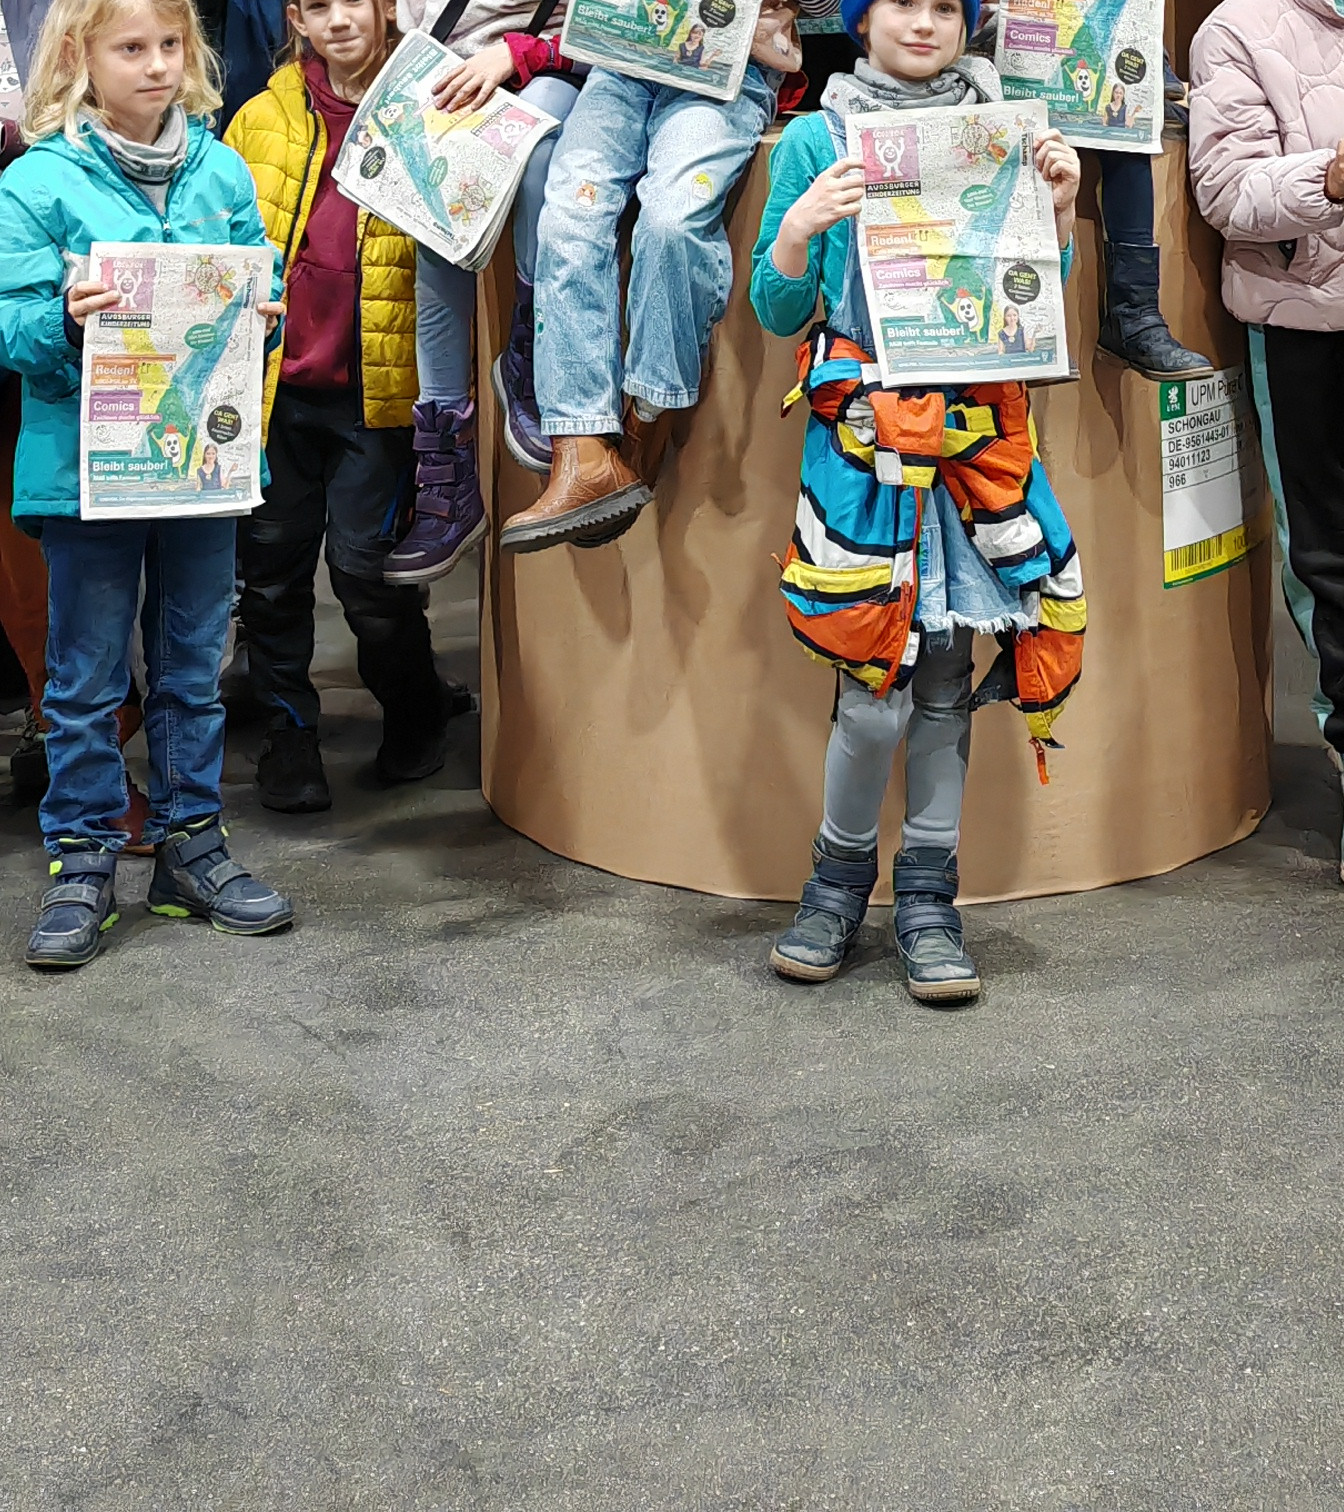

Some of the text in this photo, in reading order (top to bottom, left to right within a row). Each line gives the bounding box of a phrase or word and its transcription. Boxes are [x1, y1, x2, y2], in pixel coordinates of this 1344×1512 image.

[577, 4, 653, 35] Bleibt sauber!
[1010, 29, 1051, 44] Comics
[1003, 85, 1080, 103] Bleibt sauber!
[876, 268, 921, 279] Comics
[887, 325, 965, 338] Bleibt sauber!
[1191, 381, 1217, 407] UPM
[94, 401, 135, 412] Comics
[1168, 409, 1220, 434] SCHONGAU
[1168, 425, 1230, 453] DE-9561443-01
[93, 461, 169, 471] Bleibt sauber!
[1169, 449, 1211, 471] 94011123
[1169, 473, 1186, 489] 966
